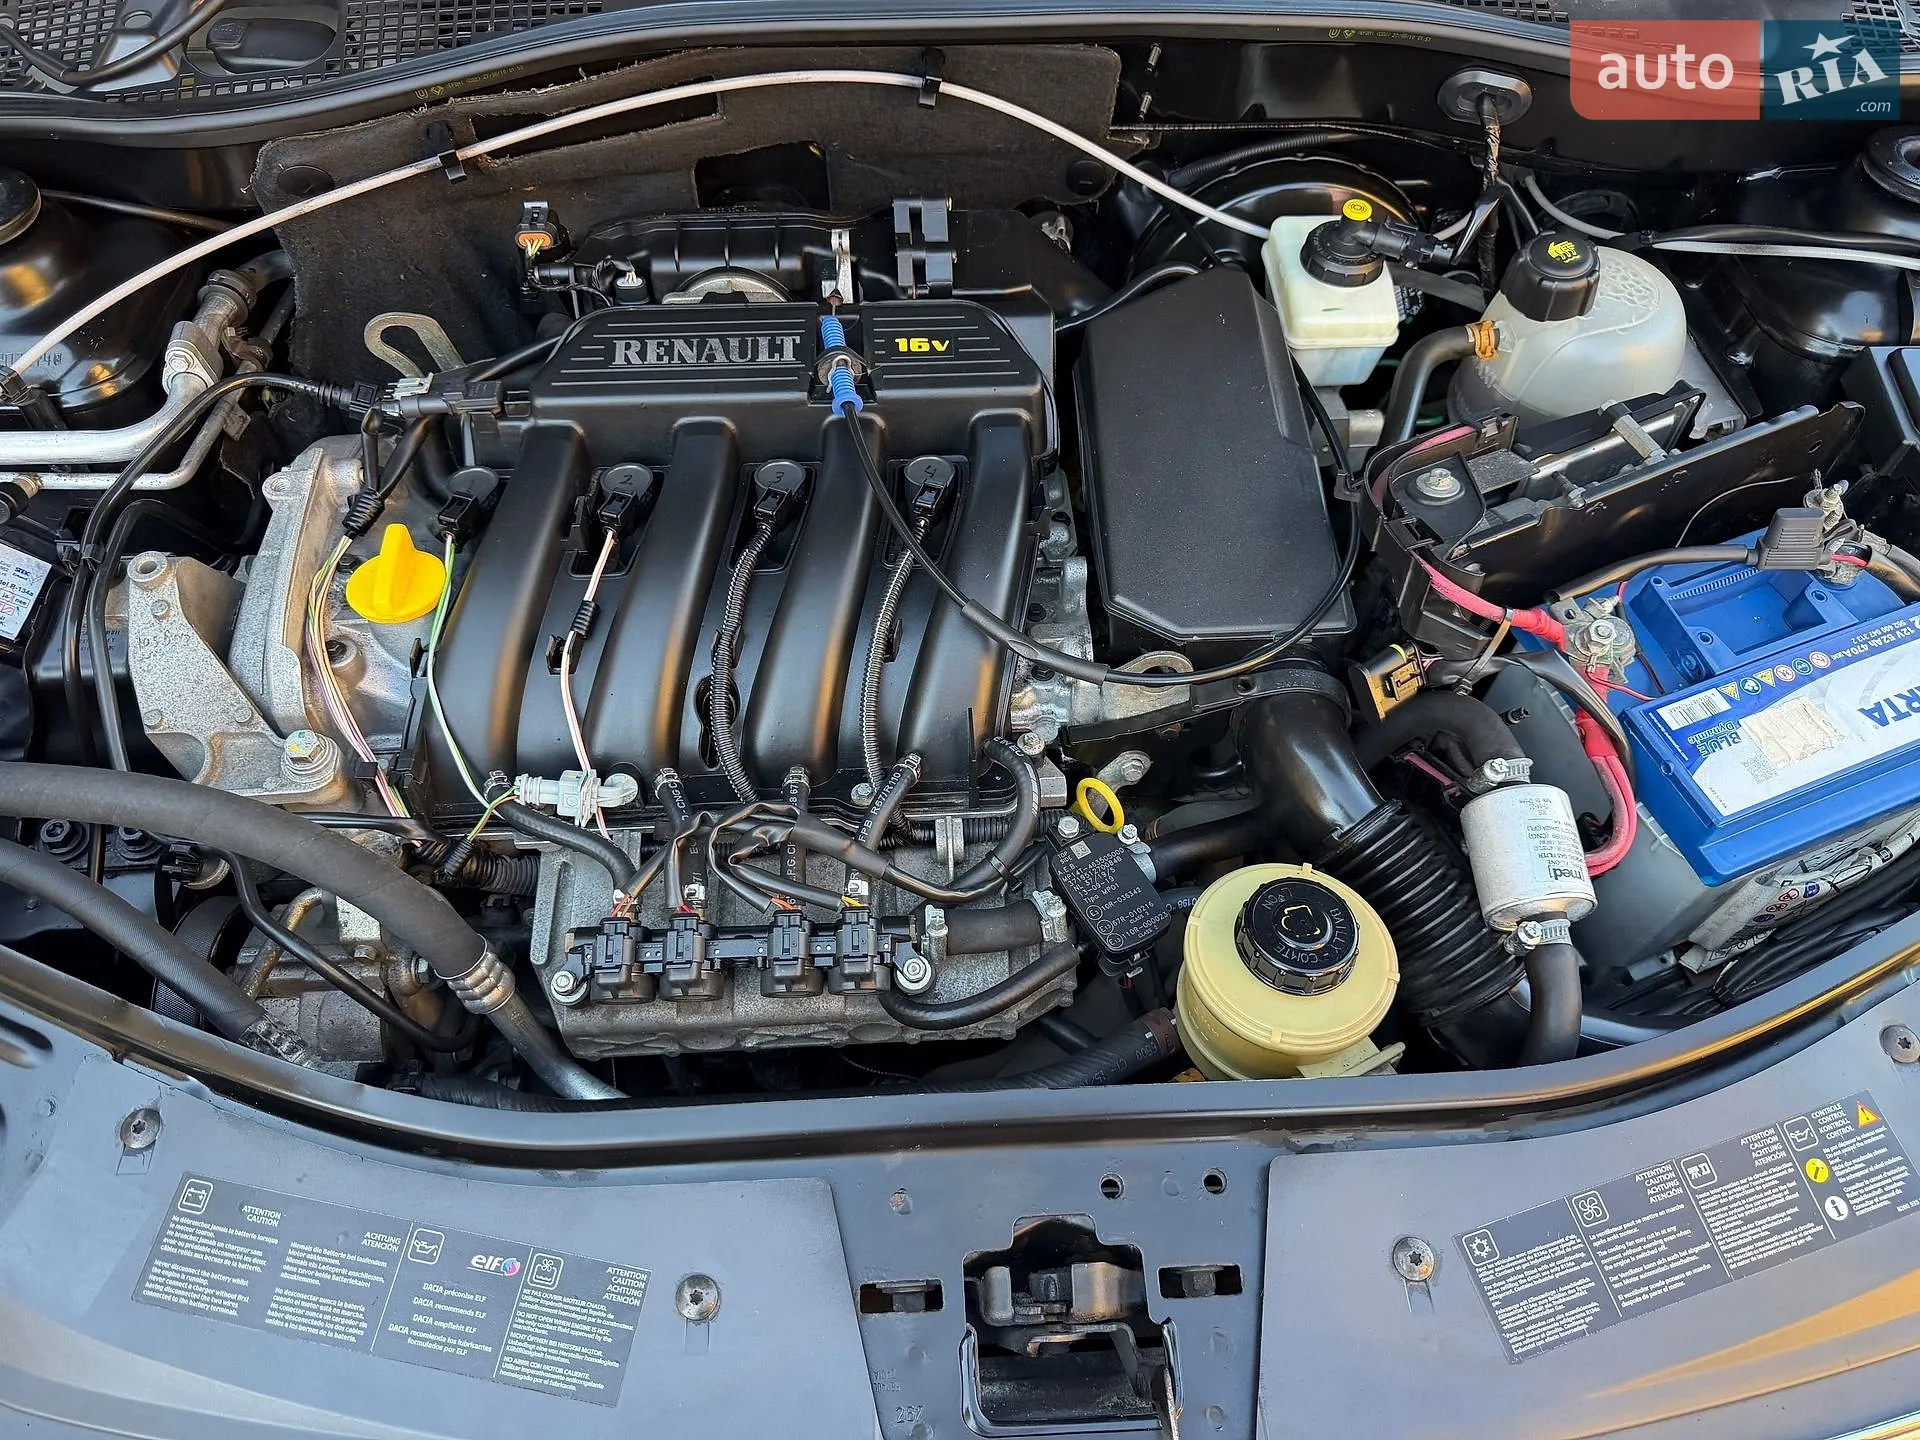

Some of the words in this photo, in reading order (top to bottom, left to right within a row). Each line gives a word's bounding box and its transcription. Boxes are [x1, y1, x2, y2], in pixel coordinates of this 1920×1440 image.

[612, 336, 800, 366] RENAULT
[772, 471, 785, 485] 3
[1857, 686, 1920, 727] RTA
[1687, 719, 1736, 745] Dynamic
[1697, 730, 1741, 758] BLUE
[1058, 863, 1078, 876] A.E.B.
[1811, 1102, 1842, 1118] CONTROLE
[1818, 1110, 1846, 1124] CONTROL
[1818, 1118, 1850, 1134] KONTROLL
[1826, 1125, 1854, 1140] CONTROL
[1740, 1128, 1776, 1145] ATTENTION
[1750, 1135, 1779, 1150] CAUTION
[1752, 1142, 1782, 1158] ACHTUNG
[1755, 1150, 1787, 1167] ATENCIÓN
[1636, 1164, 1672, 1182] ATTENTION
[1645, 1171, 1676, 1187] CAUTION
[1647, 1179, 1680, 1195] ACHTUNG
[1650, 1187, 1683, 1204] ATENCIÓN
[242, 1205, 281, 1220] ATTENTION
[246, 1214, 279, 1227] CAUTION
[361, 1239, 399, 1252] ATENCIÓN
[364, 1232, 401, 1245] ACHTUNG
[470, 1255, 504, 1271] elf
[606, 1267, 647, 1281] ATTENTION
[422, 1283, 443, 1293] DACIA
[606, 1284, 643, 1297] ACHTUNG
[612, 1276, 645, 1289] CAUTION
[413, 1297, 433, 1308] DACIA
[434, 1304, 474, 1316] recommends
[602, 1292, 640, 1306] ATENCIÓN
[412, 1314, 433, 1325] DACIA
[465, 1326, 477, 1334] ELF
[388, 1323, 409, 1334] DACIA
[410, 1330, 446, 1342] recomienda
[457, 1339, 492, 1352] lubricantes
[407, 1337, 443, 1350] formulados
[456, 1348, 468, 1356] ELF
